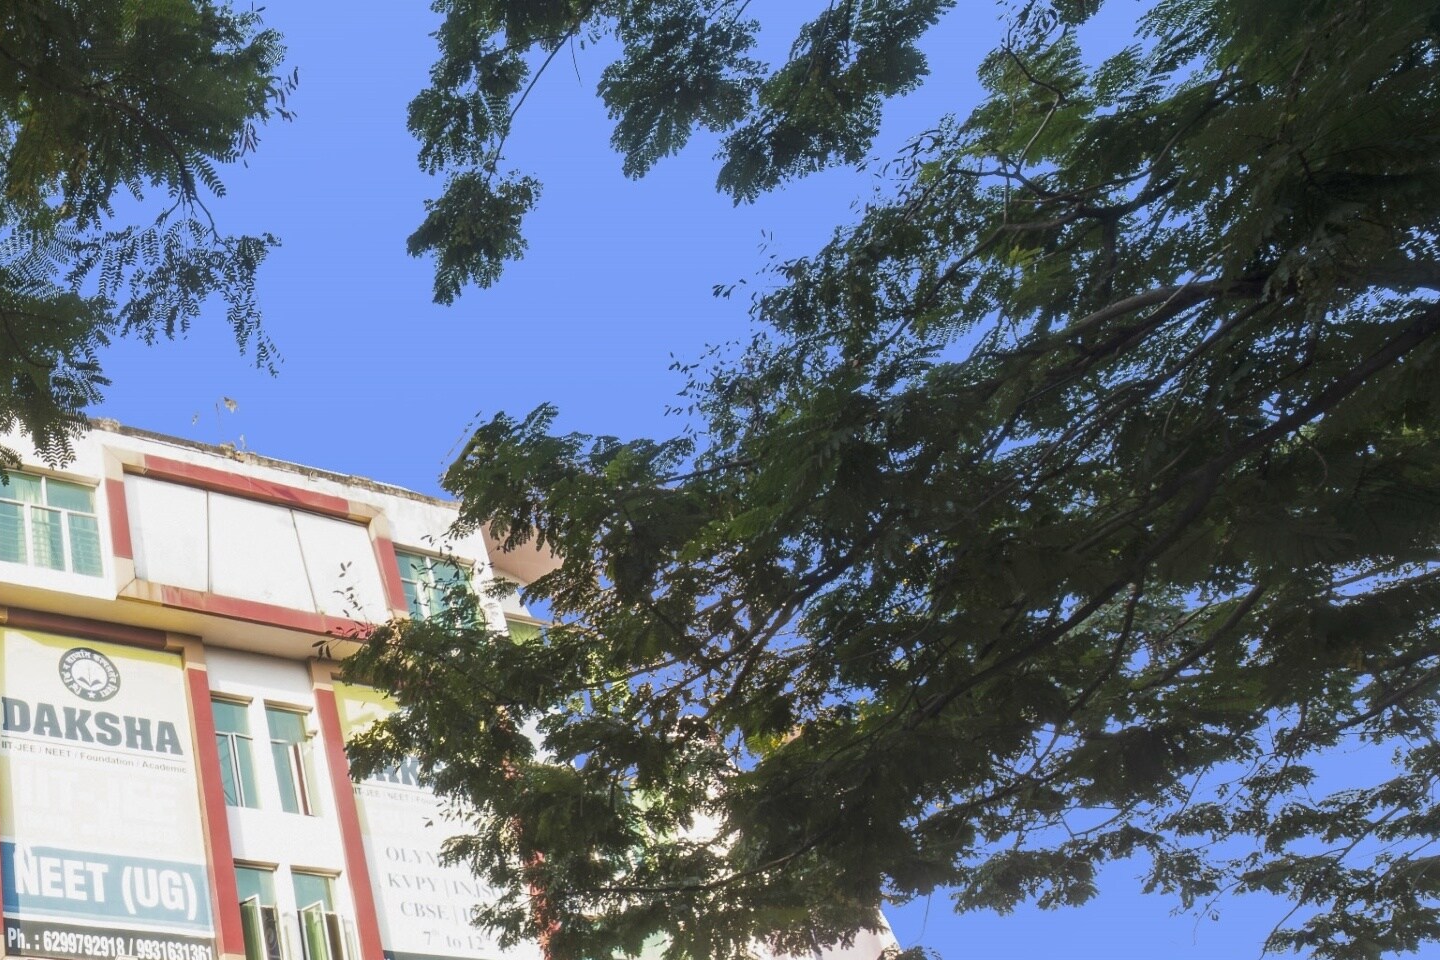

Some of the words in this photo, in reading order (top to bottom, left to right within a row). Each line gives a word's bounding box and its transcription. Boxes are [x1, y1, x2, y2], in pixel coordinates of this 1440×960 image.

[1, 696, 184, 756] DAKSHA
[45, 747, 71, 758] NEET
[79, 752, 134, 768] Foundation
[142, 760, 188, 774] Academic
[13, 846, 108, 902] NEET
[122, 865, 198, 921] (UG)
[400, 901, 450, 921] CBSE
[7, 927, 31, 951] Ph.
[43, 930, 125, 958] 6299792918
